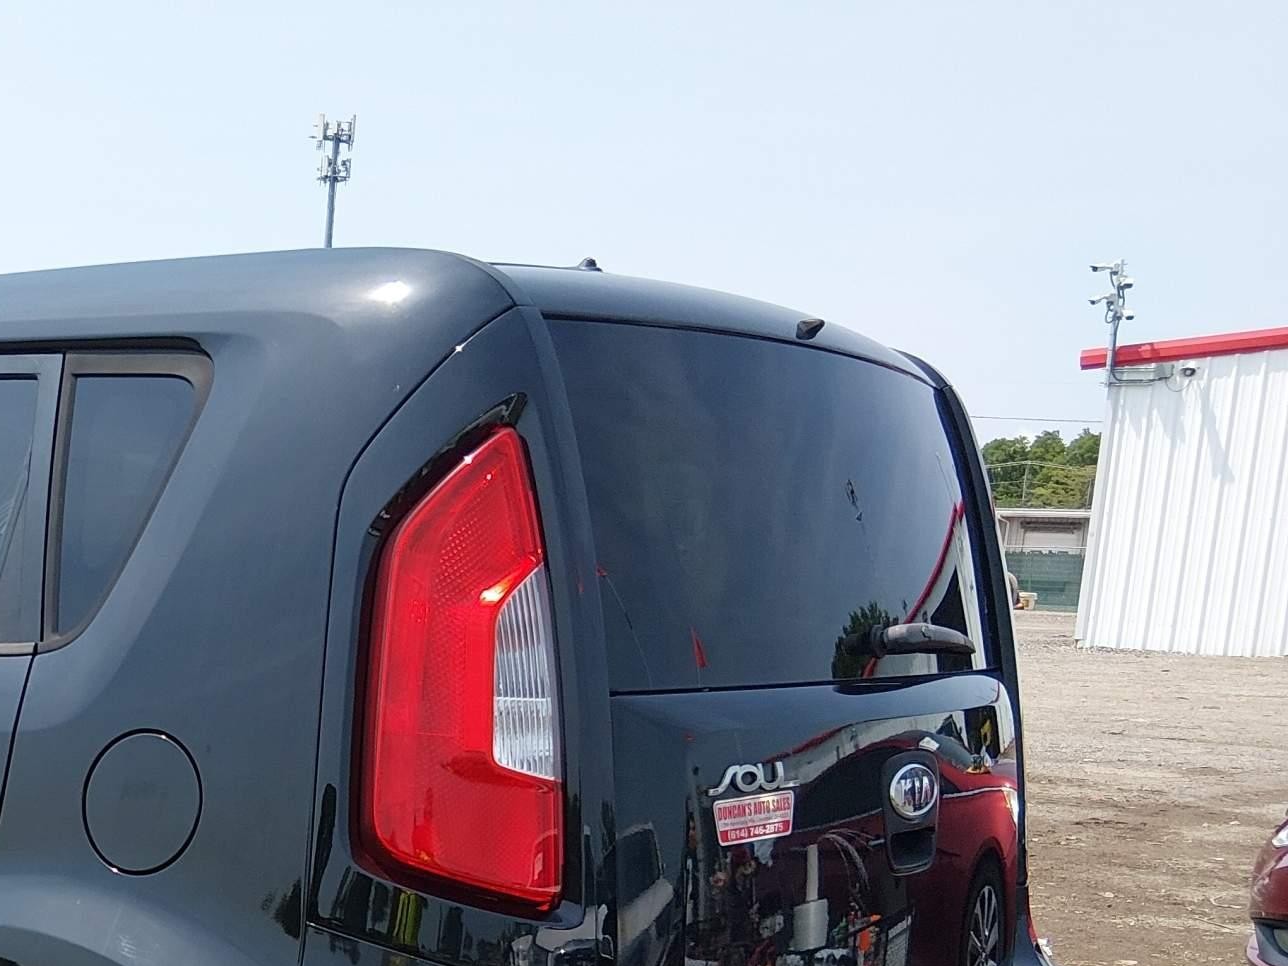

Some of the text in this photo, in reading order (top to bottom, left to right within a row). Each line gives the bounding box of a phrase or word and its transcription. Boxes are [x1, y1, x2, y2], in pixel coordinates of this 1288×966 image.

[708, 761, 800, 796] SOUL
[717, 803, 753, 820] DUNCAN'S
[753, 800, 771, 815] AUTO
[772, 797, 791, 811] SALES
[728, 829, 748, 841] (614)
